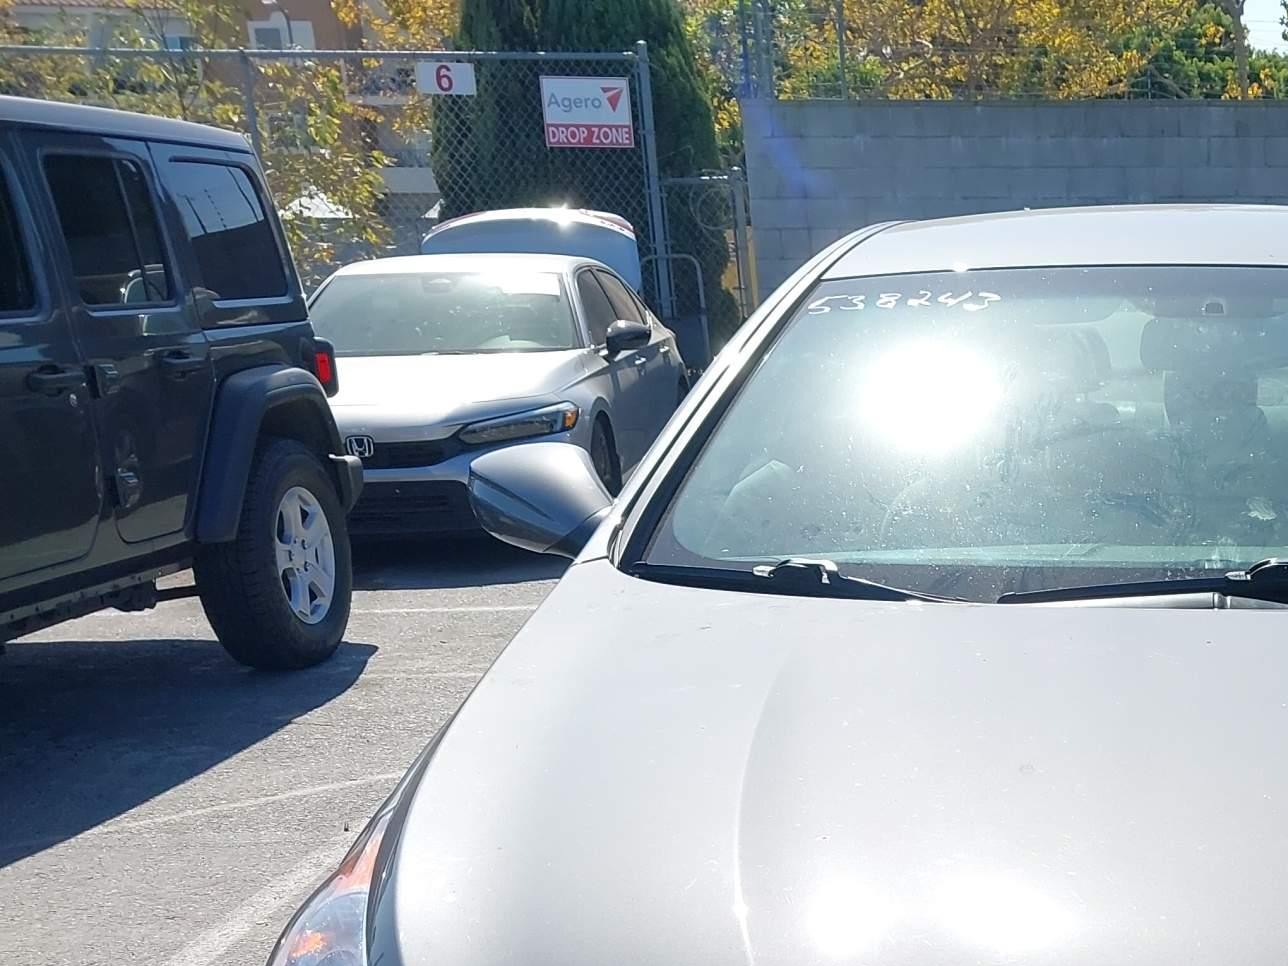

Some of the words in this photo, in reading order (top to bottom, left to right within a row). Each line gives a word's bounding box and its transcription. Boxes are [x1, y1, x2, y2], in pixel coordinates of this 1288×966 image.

[435, 64, 453, 92] 6
[547, 92, 602, 113] Agero
[548, 126, 588, 143] DROP
[591, 127, 630, 144] ZONE
